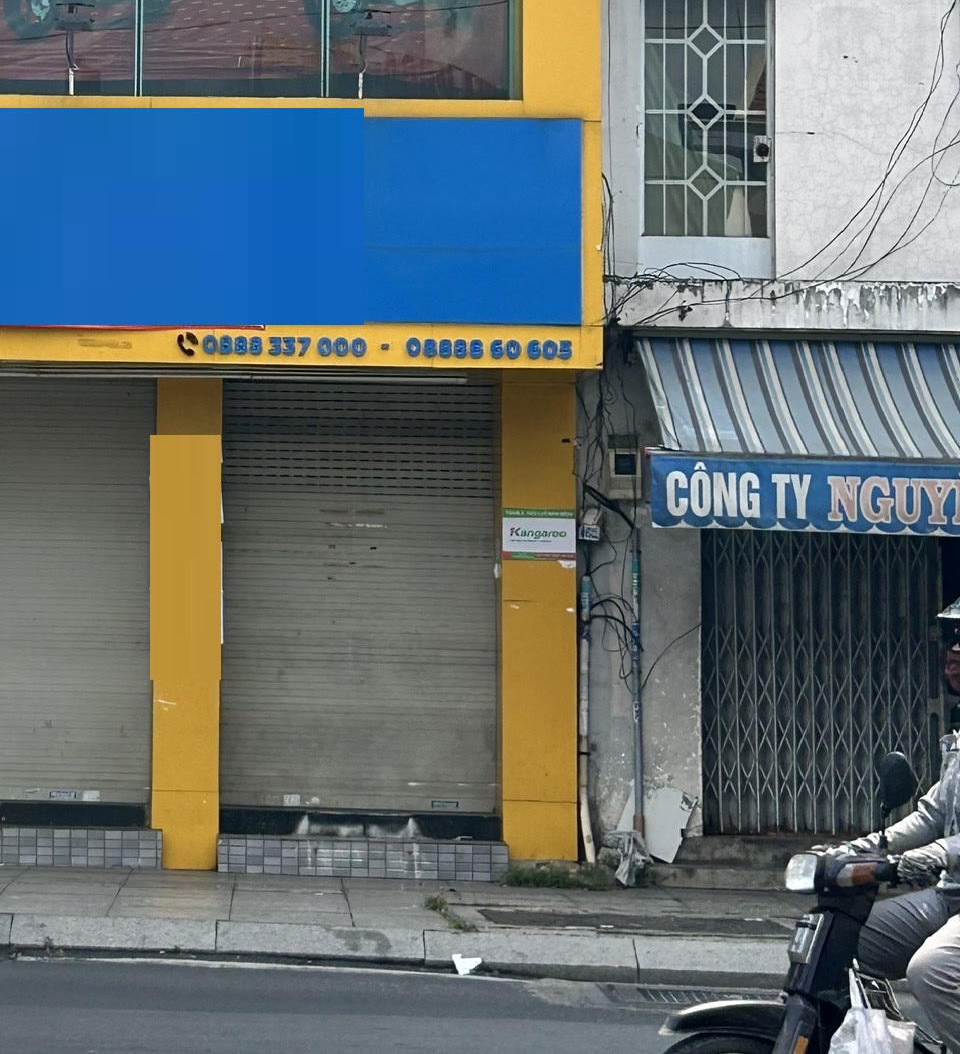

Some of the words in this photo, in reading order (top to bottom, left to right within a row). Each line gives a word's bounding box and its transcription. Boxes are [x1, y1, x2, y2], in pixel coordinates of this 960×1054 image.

[202, 334, 263, 355] 0888
[268, 336, 311, 357] 337
[317, 337, 367, 357] 000
[666, 462, 761, 518] CÔNG
[771, 474, 811, 520] TY
